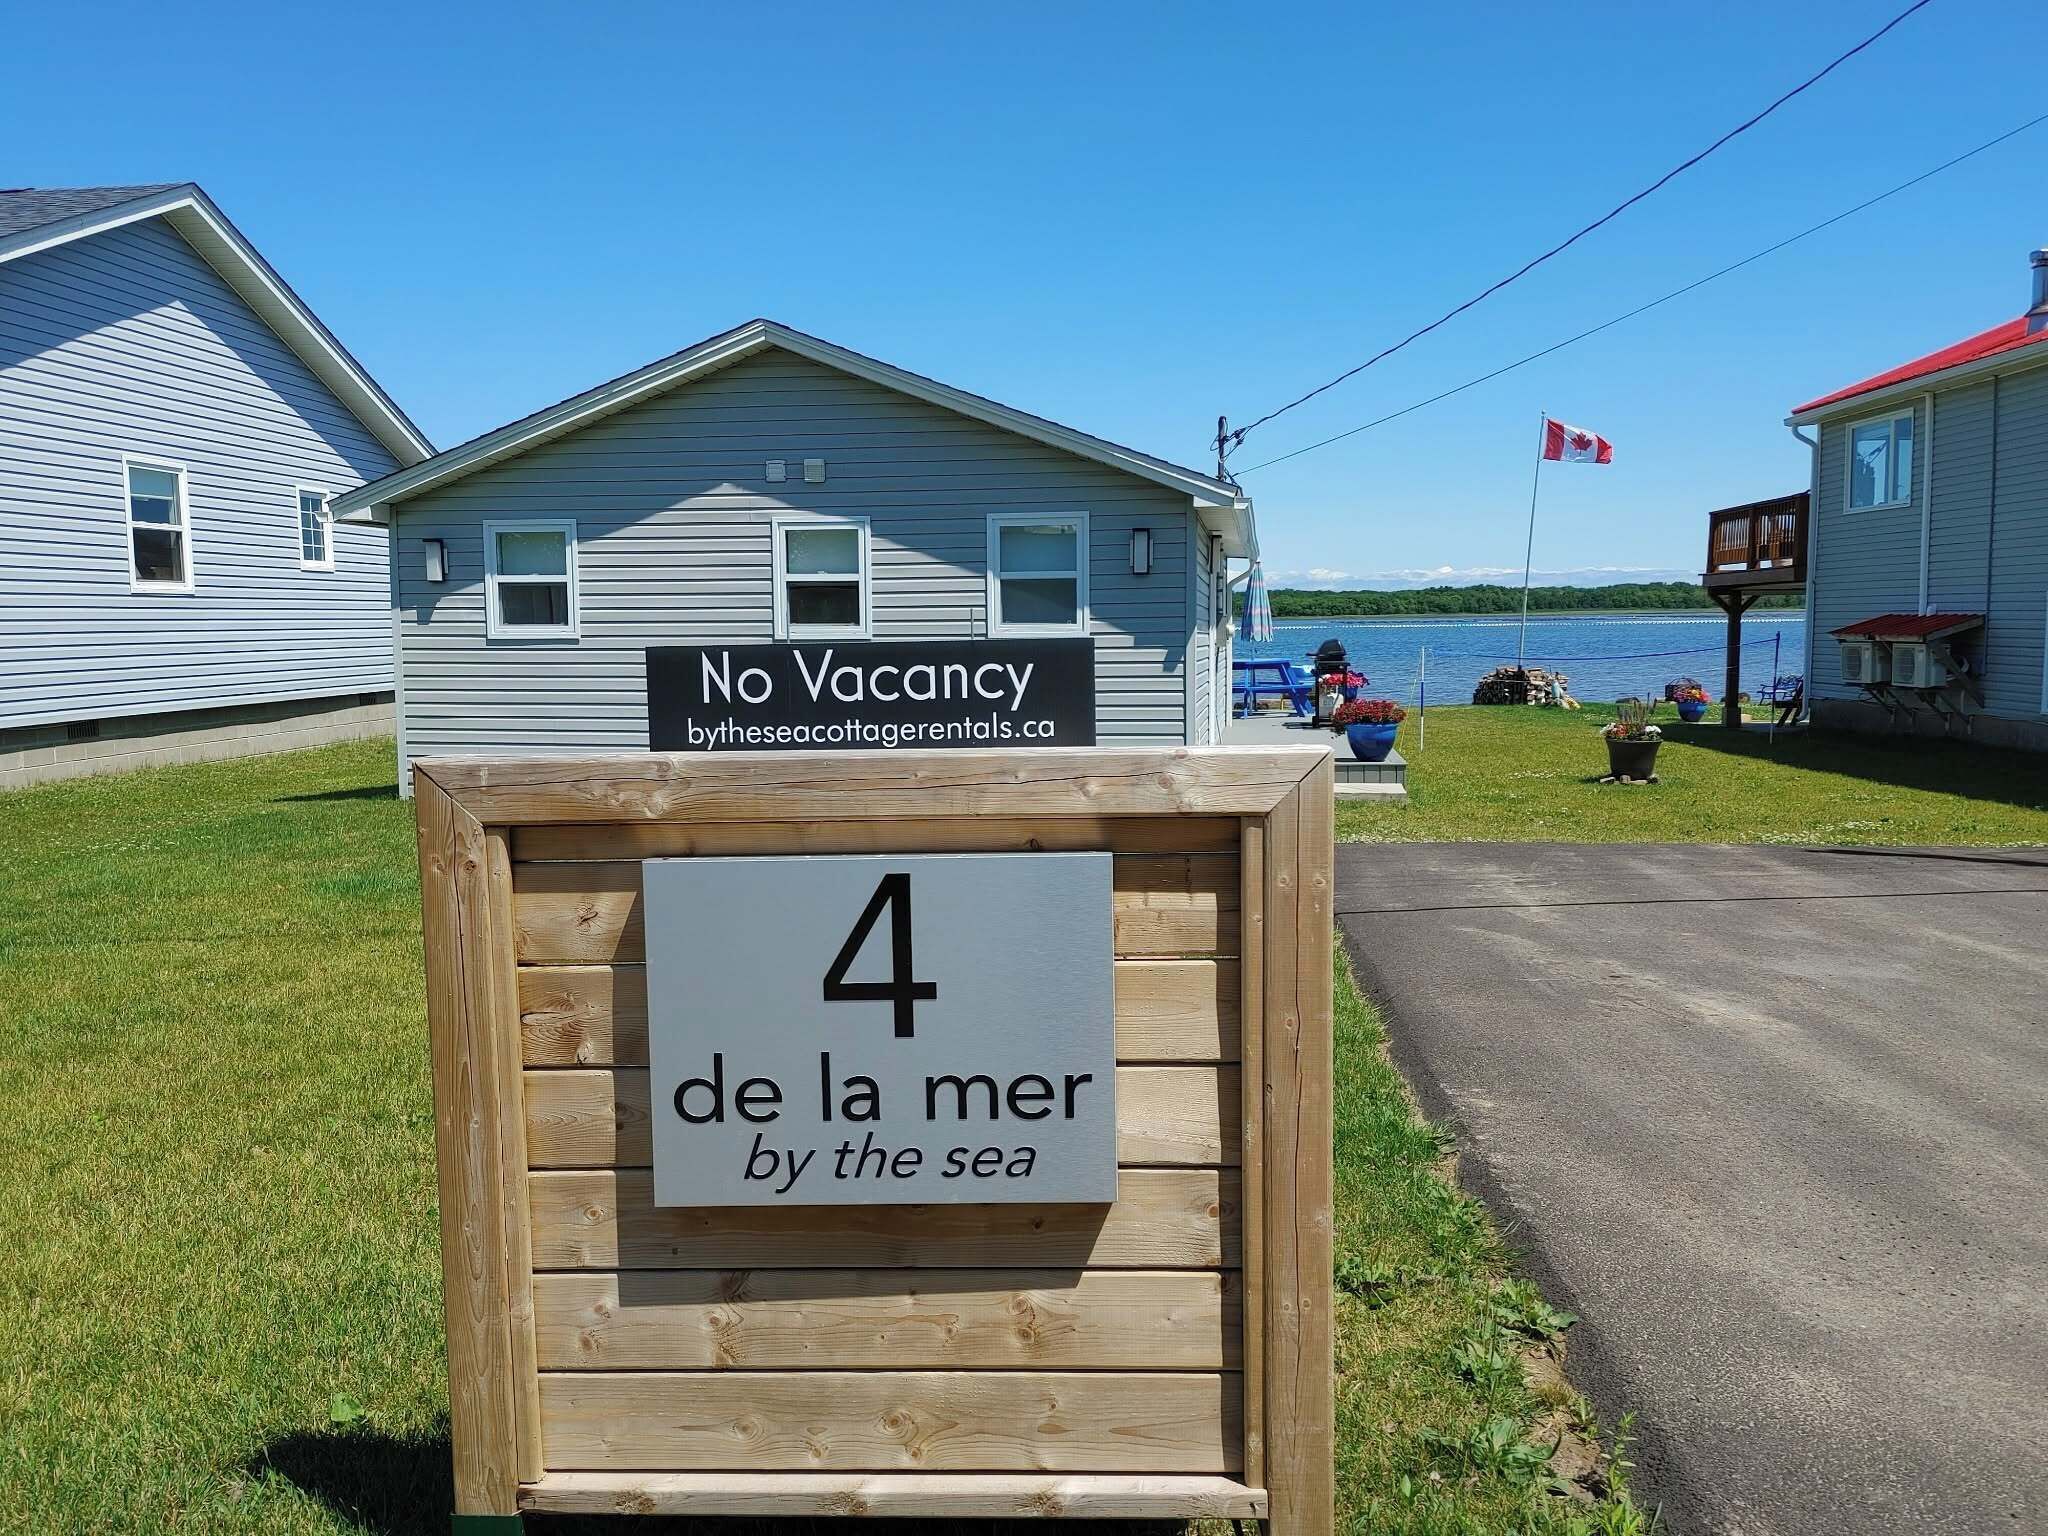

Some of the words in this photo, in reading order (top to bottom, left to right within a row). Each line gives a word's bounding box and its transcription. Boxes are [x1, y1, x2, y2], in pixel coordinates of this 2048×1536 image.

[701, 650, 773, 704] No
[793, 649, 1034, 711] Vacancy
[687, 712, 1055, 750] bytheseacottagerentals.ca
[823, 873, 937, 1038] 4
[673, 1052, 783, 1123] de
[820, 1051, 881, 1121] la
[925, 1071, 1093, 1121] mer
[743, 1132, 816, 1194] by
[833, 1131, 923, 1179] the
[941, 1144, 1037, 1179] sea
